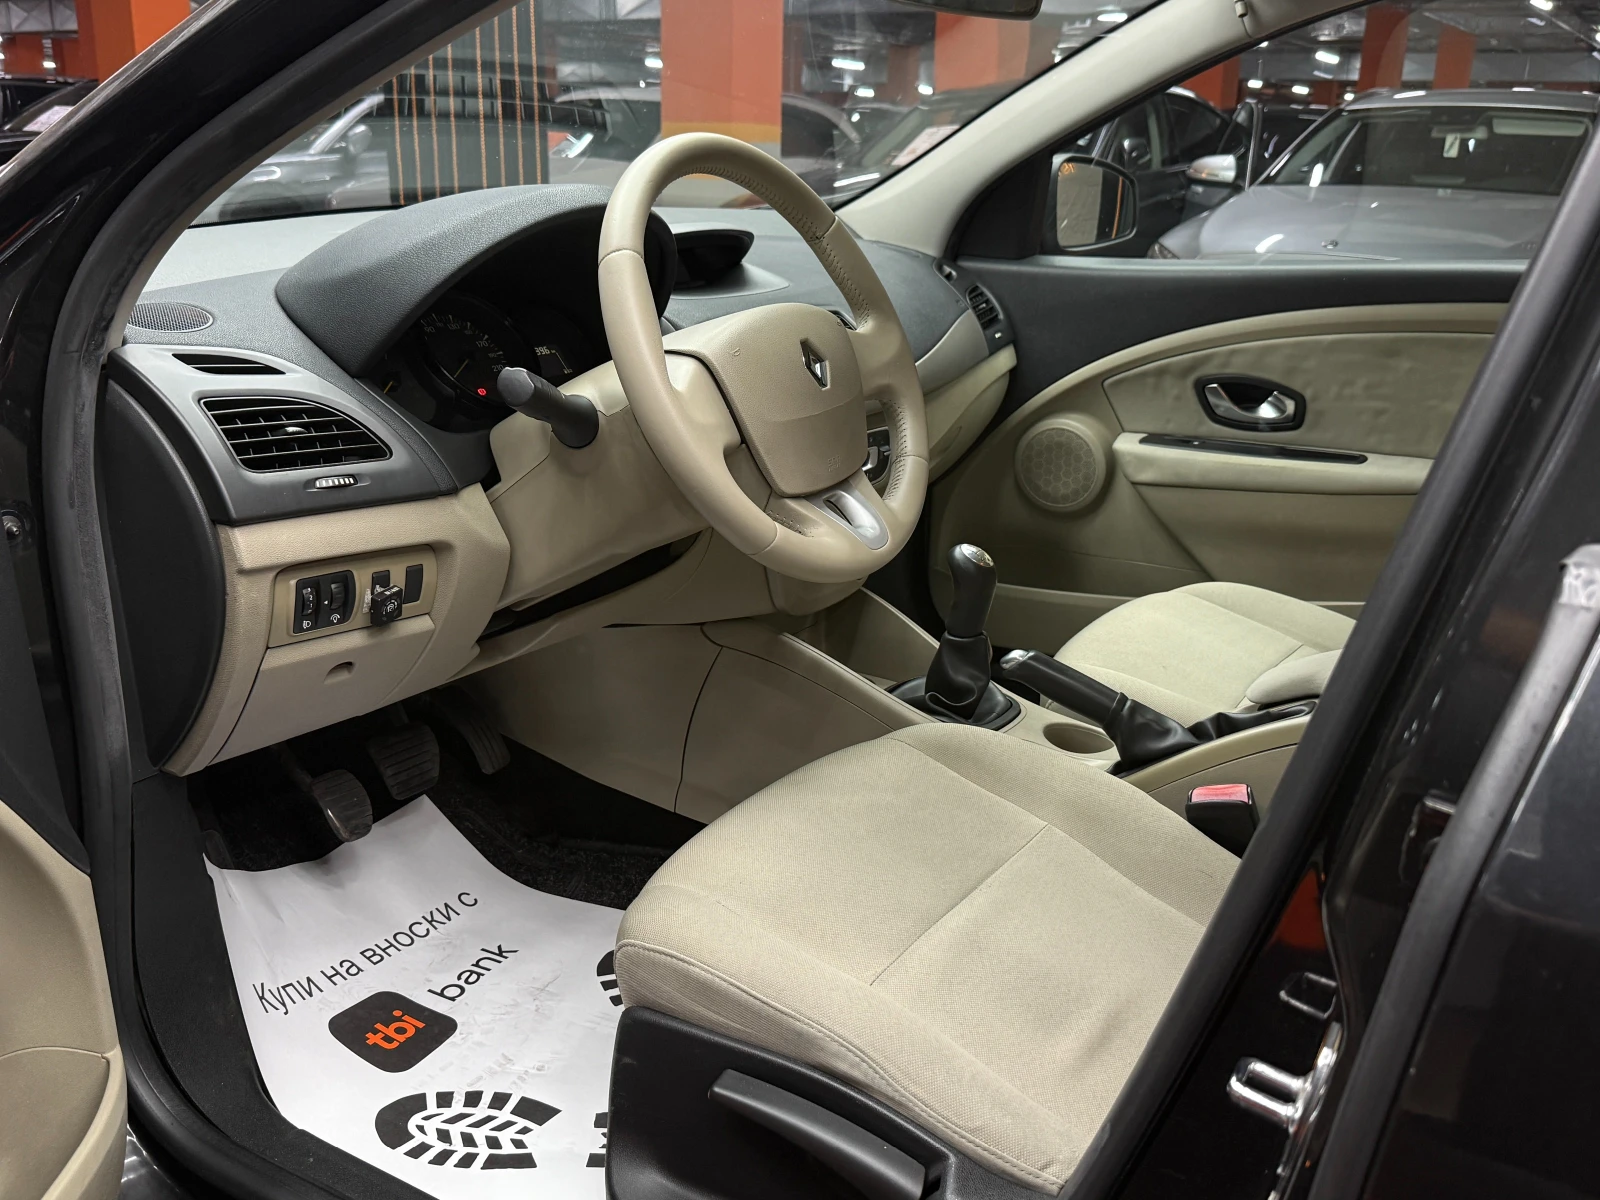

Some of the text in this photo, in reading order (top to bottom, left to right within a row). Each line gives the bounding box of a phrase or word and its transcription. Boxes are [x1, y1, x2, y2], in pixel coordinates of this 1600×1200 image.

[424, 326, 436, 334] 90
[475, 340, 489, 348] 170
[534, 346, 551, 356] 396
[253, 891, 479, 1015] Купи на вноски с
[366, 943, 519, 1050] tbi bank
